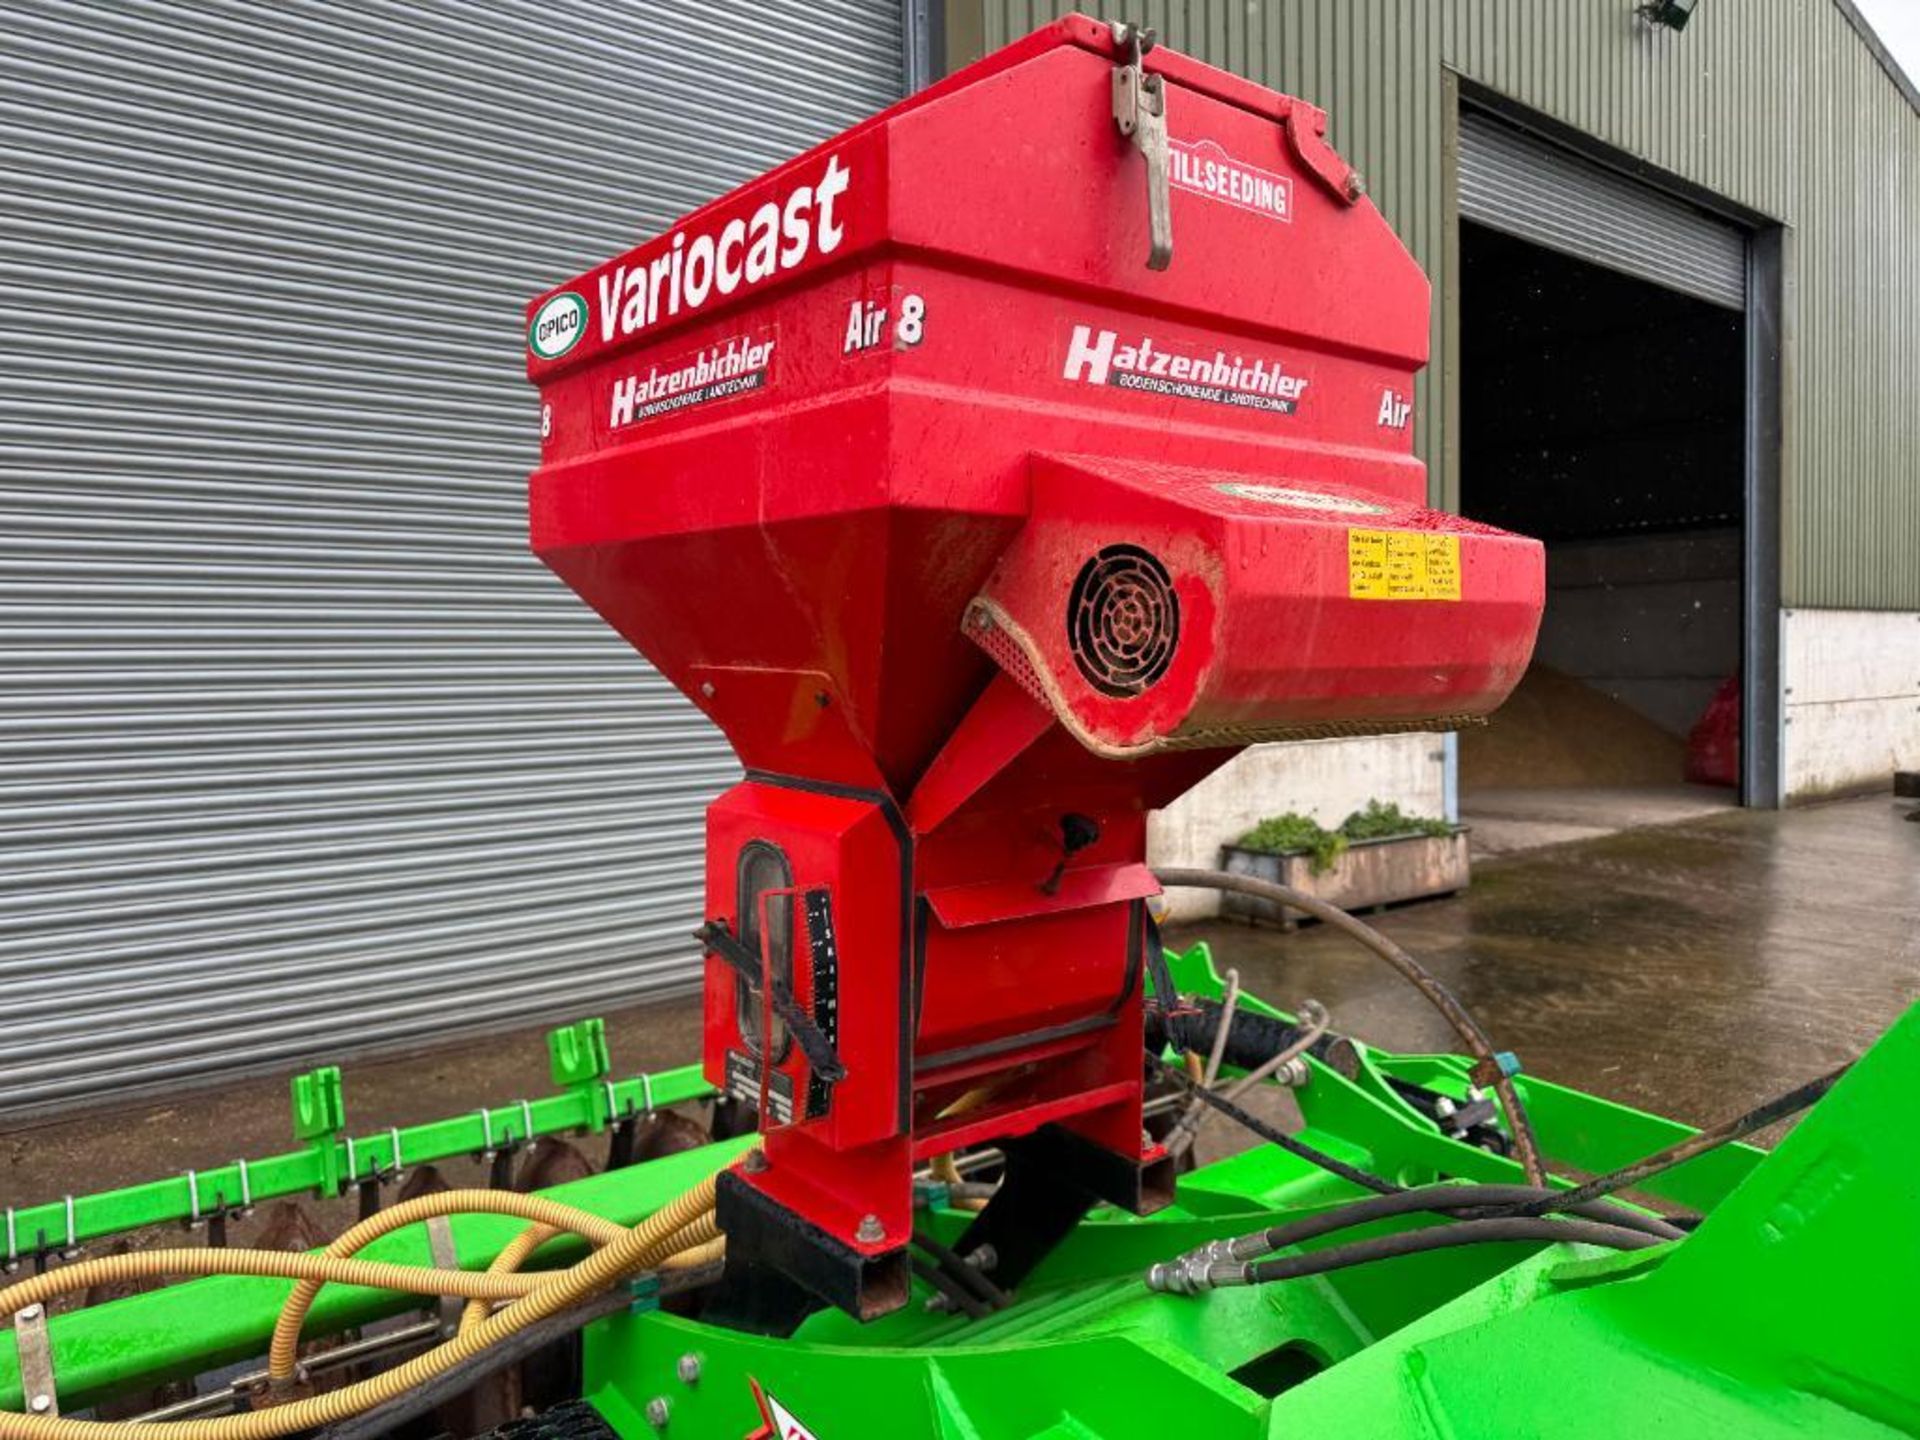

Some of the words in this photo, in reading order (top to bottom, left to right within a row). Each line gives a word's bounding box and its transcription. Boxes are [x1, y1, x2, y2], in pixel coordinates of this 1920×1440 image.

[599, 155, 850, 342] Variocast
[538, 309, 578, 342] OPICO
[844, 300, 887, 353] Air
[898, 294, 925, 345] 8
[610, 337, 776, 428] Hatzenbichler
[1063, 325, 1308, 399] Hatzenbichler
[542, 404, 551, 437] 8
[1378, 389, 1411, 428] Air
